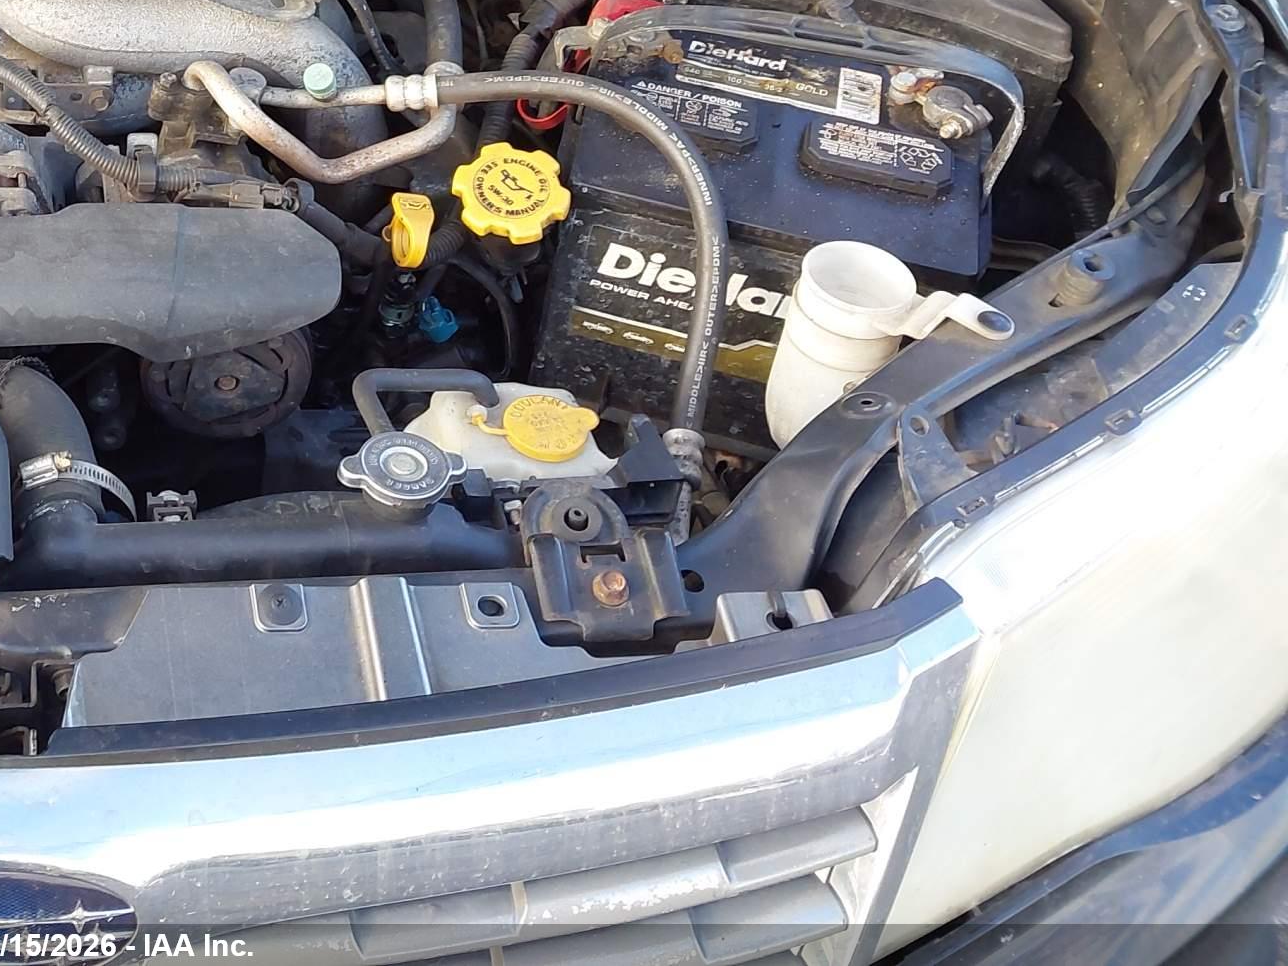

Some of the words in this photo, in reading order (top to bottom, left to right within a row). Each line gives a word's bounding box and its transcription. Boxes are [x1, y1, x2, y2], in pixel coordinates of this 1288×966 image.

[688, 40, 788, 72] DieHard
[647, 82, 692, 99] DANGER
[702, 94, 743, 109] POISON
[795, 82, 829, 97] GOLD
[481, 161, 499, 175] SEE
[505, 199, 545, 216] MANUAL
[503, 158, 542, 176] ENGINE
[539, 178, 548, 193] OIL
[487, 184, 515, 206] 5W-30
[589, 279, 651, 300] POWER
